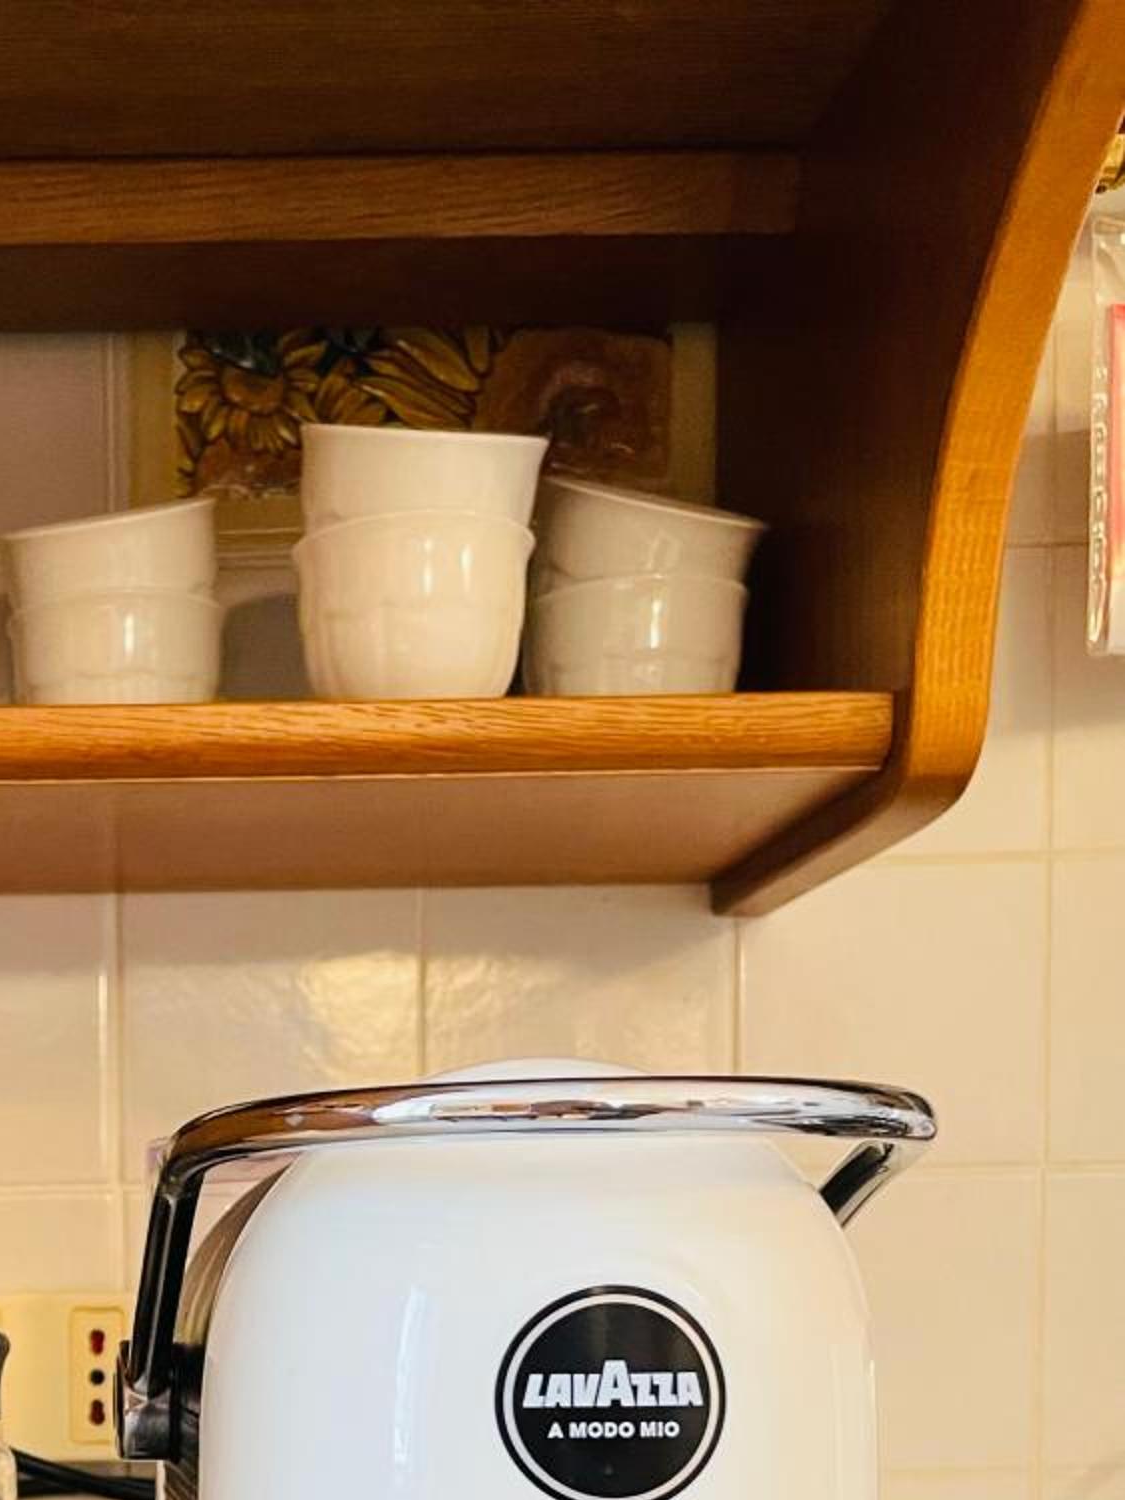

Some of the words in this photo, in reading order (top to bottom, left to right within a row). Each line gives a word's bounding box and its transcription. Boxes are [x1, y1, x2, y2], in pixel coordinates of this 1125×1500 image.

[522, 1359, 705, 1408] LAVAZZA
[547, 1421, 564, 1439] A
[568, 1420, 635, 1439] MODO
[639, 1420, 681, 1438] MIO
